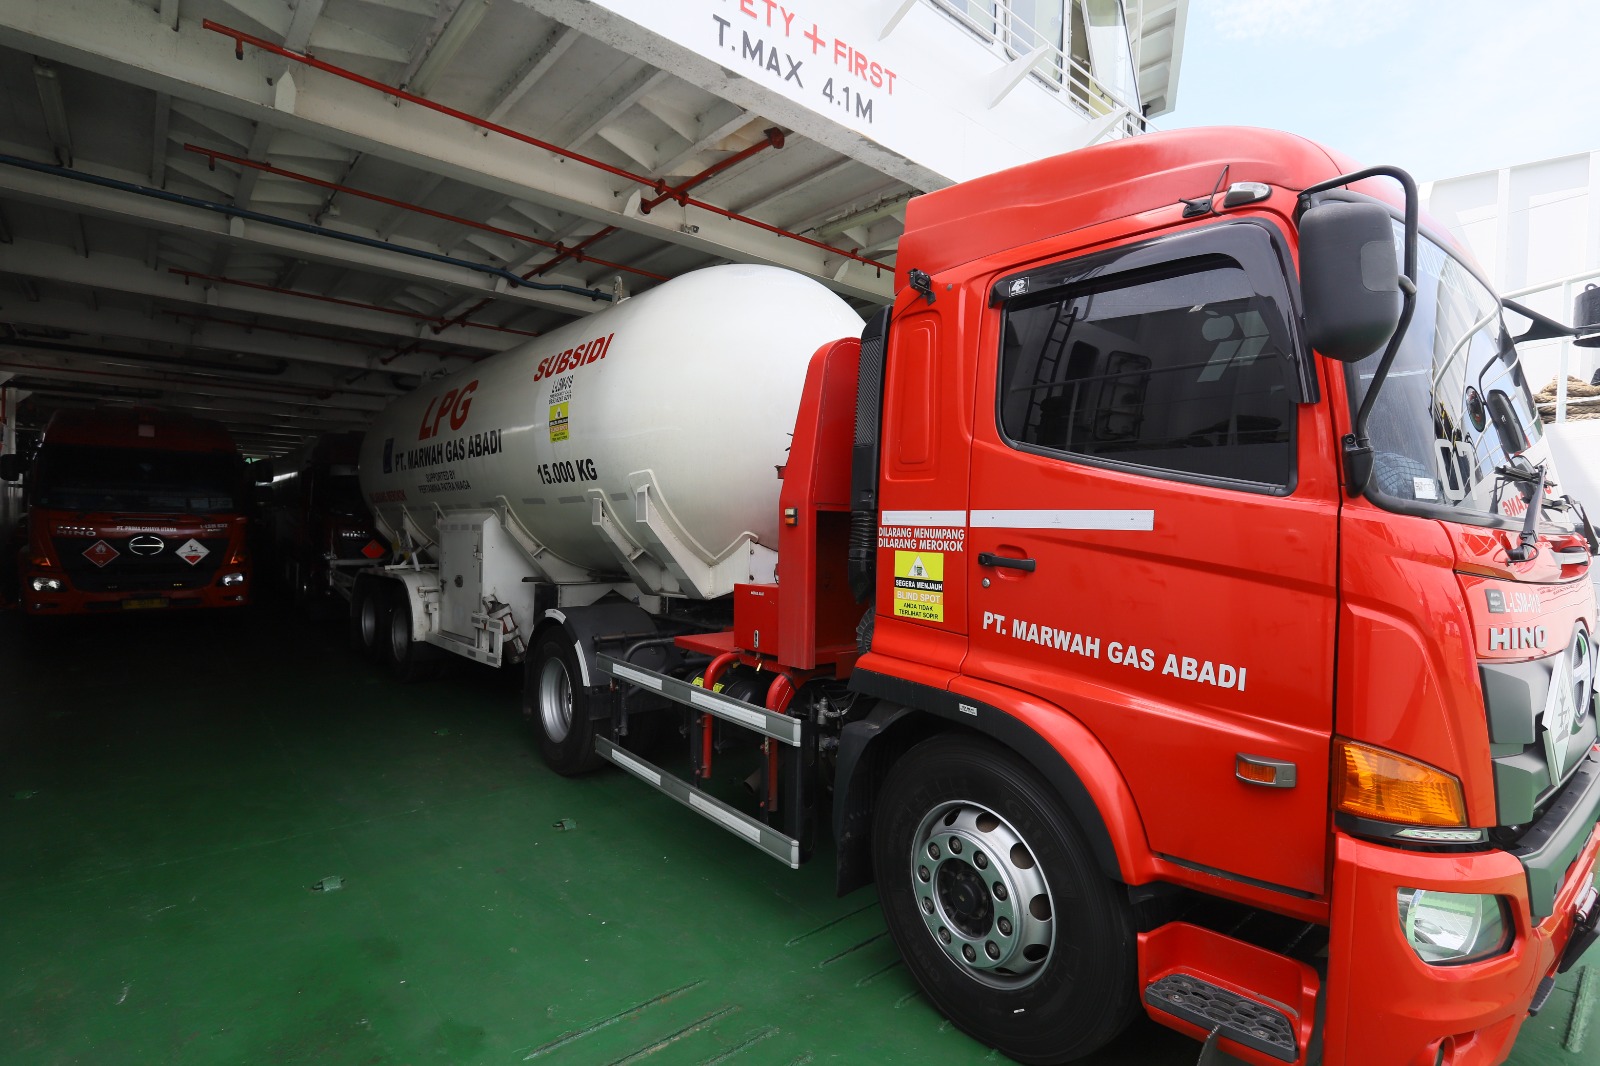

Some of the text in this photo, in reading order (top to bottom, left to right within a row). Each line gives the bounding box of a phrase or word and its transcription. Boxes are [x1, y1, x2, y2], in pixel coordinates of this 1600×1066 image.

[834, 38, 897, 95] FIRST
[822, 77, 873, 124] 4.1M
[534, 333, 614, 381] SUBSIDI
[418, 380, 479, 440] LPG
[395, 429, 502, 472] PT. MARWAH GAS ABADI
[426, 470, 449, 483] SUPPORTED
[537, 458, 598, 485] 15.000 KG
[878, 527, 964, 540] DILARANG MENUMPANG
[878, 538, 964, 552] DILARANG MEROKOK
[896, 579, 943, 591] SEGERA MENJAUH
[897, 591, 941, 603] BLIND SPOT
[899, 609, 939, 620] TERLIHAT SOPIR
[1490, 624, 1548, 650] HINO
[983, 611, 1247, 691] PT. MARWAH GAS ABADI
